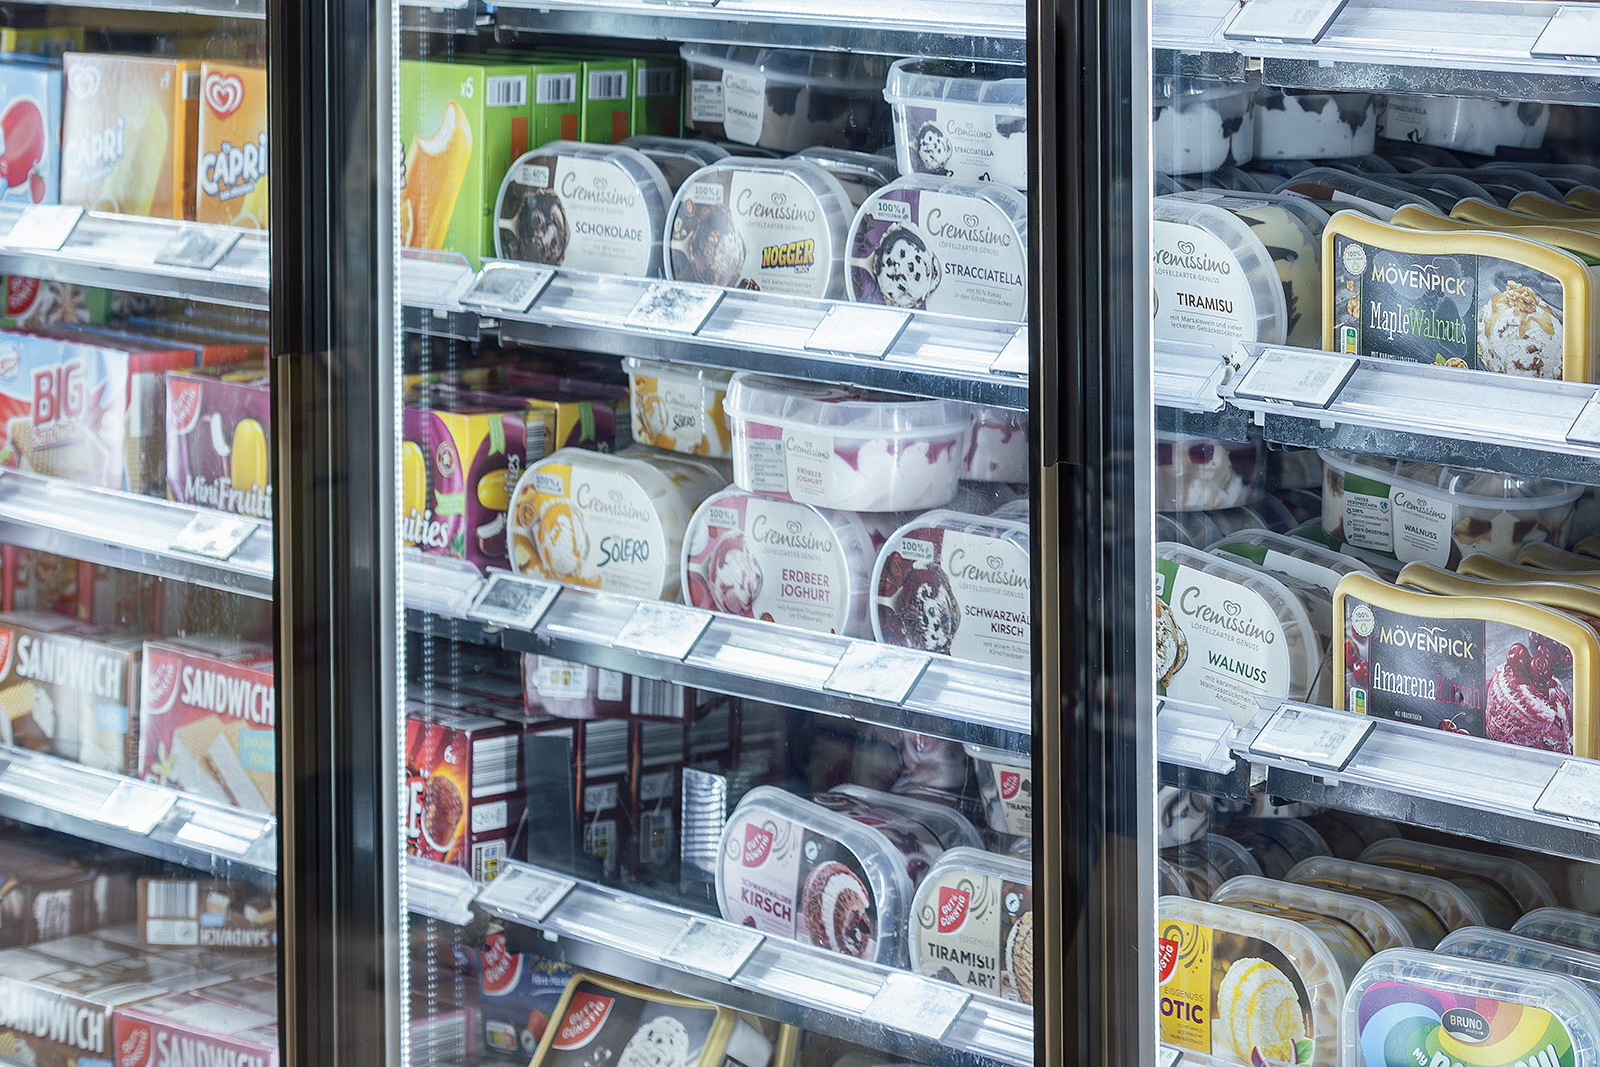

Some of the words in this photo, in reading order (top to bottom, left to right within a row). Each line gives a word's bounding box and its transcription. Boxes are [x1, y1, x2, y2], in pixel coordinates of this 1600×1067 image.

[953, 146, 994, 157] STRACCIATELLA
[561, 172, 635, 207] Cremissimo
[736, 188, 815, 224] Cremissimo
[878, 202, 900, 214] 100%
[575, 221, 643, 243] SCHOKOLADE
[926, 207, 1012, 248] Cremissimo
[762, 239, 815, 270] NOGGER
[944, 262, 1022, 287] STRACCIATELLA
[1154, 267, 1197, 280] LÖFFELZARTER
[1197, 273, 1220, 284] GENUSS
[1371, 262, 1467, 297] MÖVENPICK
[1176, 292, 1233, 313] TIRAMISU
[32, 360, 84, 425] BIG
[786, 436, 830, 460] Cremissimo
[796, 467, 823, 479] ERDBEER
[796, 474, 823, 487] JOGHURT
[577, 483, 651, 524] Cremissimo
[1394, 491, 1447, 520] Cremissimo
[752, 514, 833, 553] Cremissimo
[1404, 523, 1438, 540] WALNUSS
[901, 541, 924, 553] 100%
[782, 568, 830, 588] ERDBEER
[781, 583, 831, 603] JOGHURT
[1179, 585, 1275, 646] Cremissimo
[990, 621, 1024, 637] KIRSCH
[1190, 621, 1235, 643] LÖFFELZARTER
[1235, 637, 1260, 653] GENUSS
[1379, 623, 1475, 661] MÖVENPICK
[16, 634, 122, 700] SANDWICH
[1204, 674, 1215, 683] mit
[1207, 649, 1268, 685] WALNUSS
[181, 664, 275, 726] SANDWICH
[740, 887, 792, 923] KIRSCH
[927, 942, 995, 971] TIRAMISU
[966, 971, 995, 989] ART
[1164, 986, 1204, 1002] EISGENUSS
[1160, 997, 1204, 1024] OTIC
[1450, 1014, 1483, 1031] BRUNO
